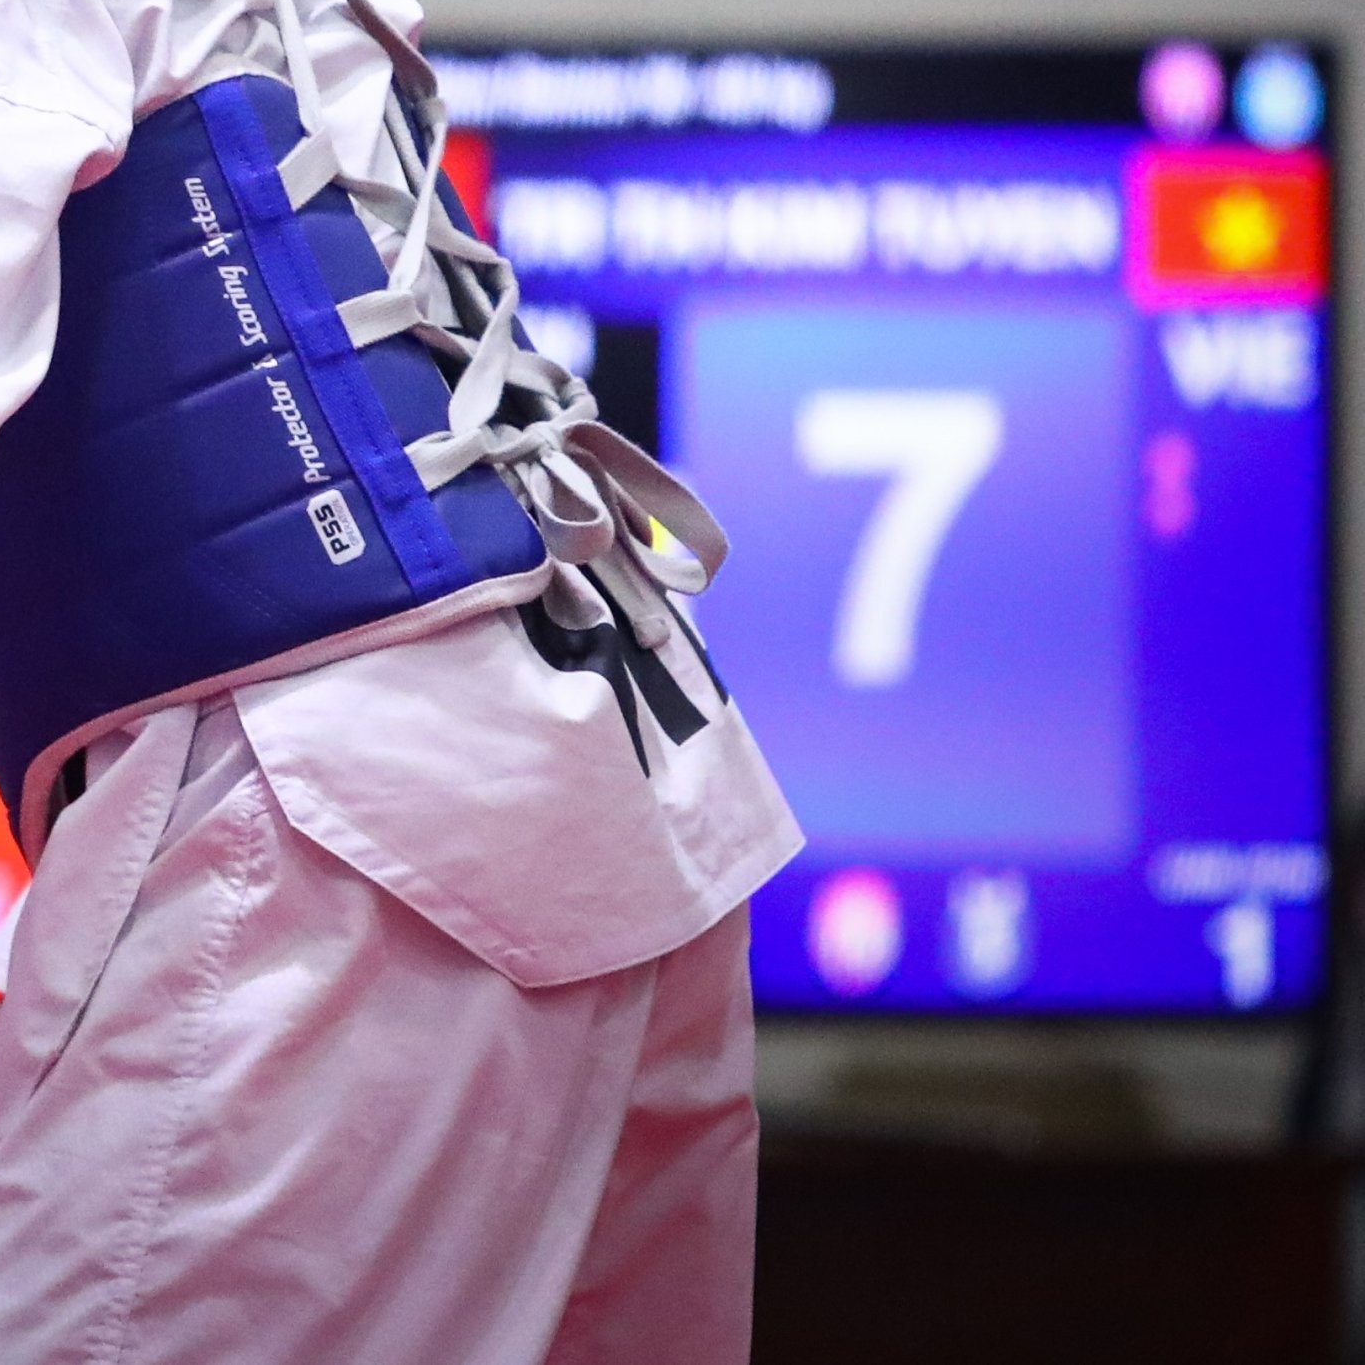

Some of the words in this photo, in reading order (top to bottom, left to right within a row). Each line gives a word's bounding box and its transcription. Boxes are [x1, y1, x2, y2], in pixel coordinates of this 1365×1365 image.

[184, 176, 233, 258] System
[217, 265, 269, 347] Scoring
[1164, 315, 1314, 407] VIE
[265, 375, 332, 484] Protector
[314, 503, 351, 555] PSS
[795, 389, 1003, 691] 7
